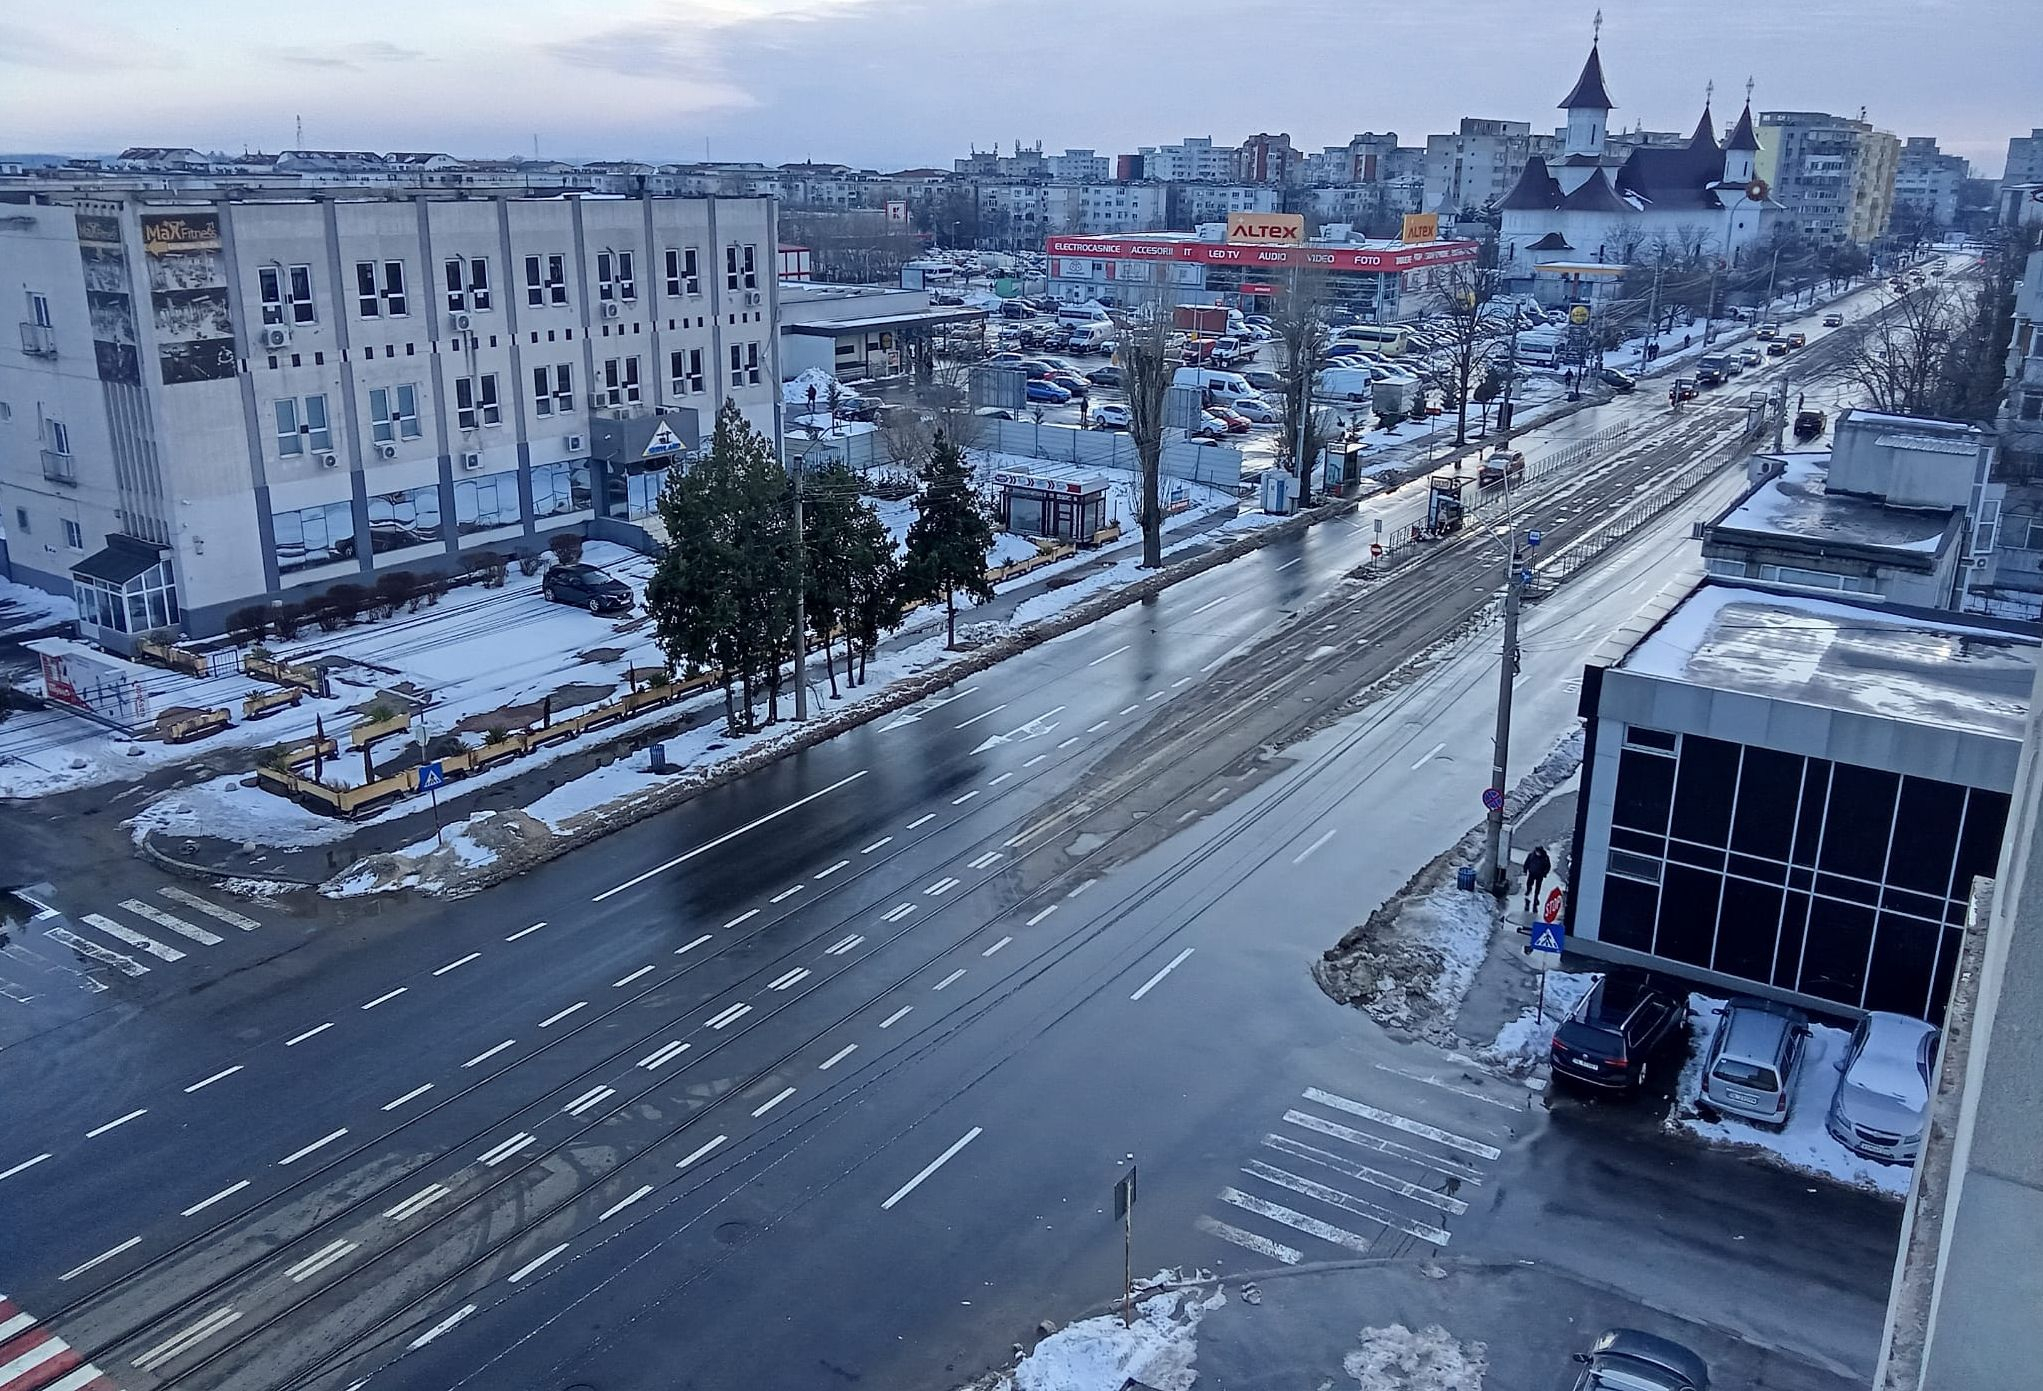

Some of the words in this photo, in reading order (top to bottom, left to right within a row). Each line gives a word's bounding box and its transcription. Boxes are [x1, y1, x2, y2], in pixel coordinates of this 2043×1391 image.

[1054, 242, 1121, 254] ELECTROCASNICE
[1131, 245, 1174, 256] ACCESORII
[1184, 248, 1192, 256] IT
[1208, 250, 1225, 258] LED
[1227, 250, 1240, 259] TV
[1258, 252, 1287, 261] AUDIO
[1307, 254, 1335, 263] VIDEO
[1354, 256, 1380, 265] FOTO
[1544, 895, 1562, 917] STOP
